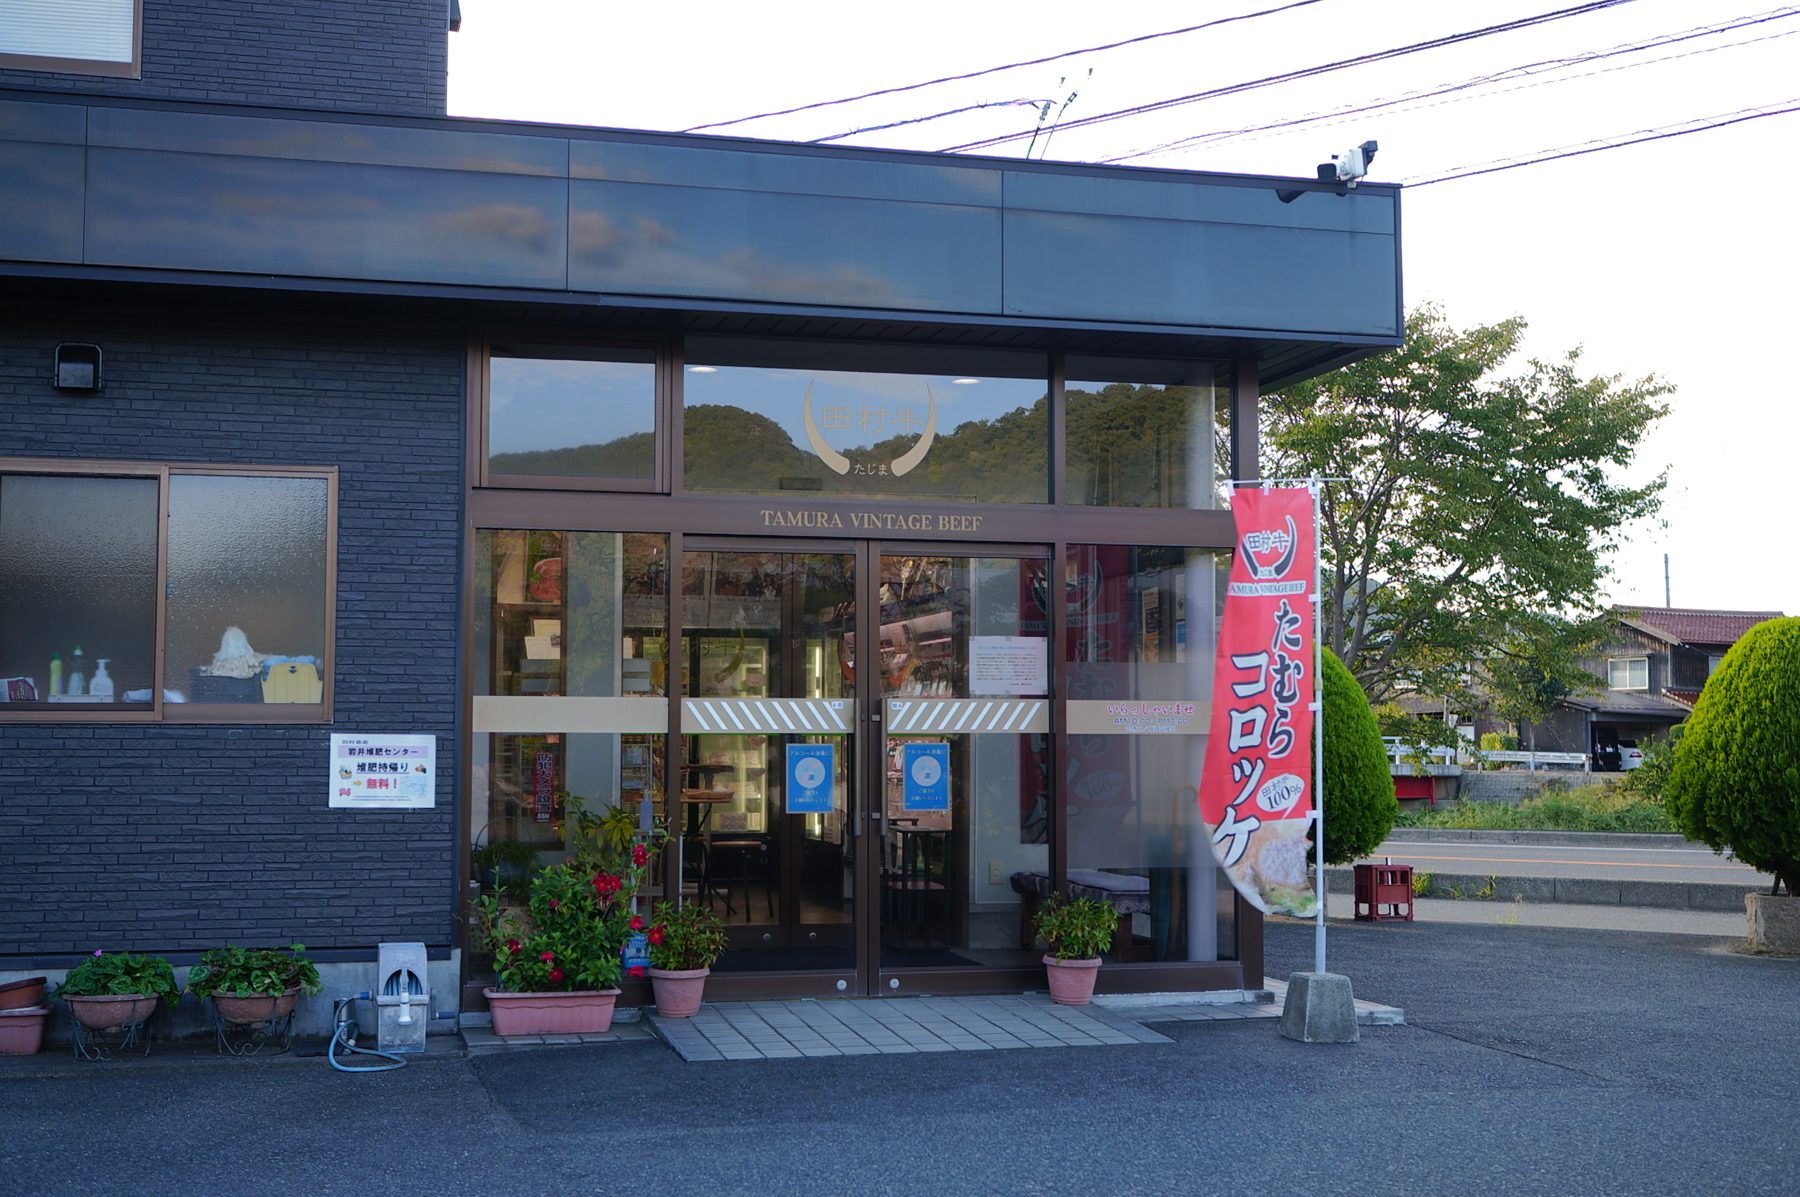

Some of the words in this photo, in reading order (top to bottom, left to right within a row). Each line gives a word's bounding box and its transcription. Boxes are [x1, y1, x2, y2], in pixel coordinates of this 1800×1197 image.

[822, 404, 923, 434] 田村牛
[853, 463, 889, 476] たじま
[760, 510, 843, 528] TAMURA
[850, 513, 932, 530] VINTAGE
[938, 515, 983, 531] BEEF
[1231, 583, 1260, 594] AMURA
[1268, 600, 1303, 757] たむら
[1107, 703, 1194, 715] いらっしゃいませ
[348, 747, 418, 756] 岩井堆肥センター
[1212, 650, 1269, 868] コロッケ
[357, 762, 409, 772] 堆肥持帰り
[366, 778, 397, 790] 無料！
[1267, 783, 1302, 810] 100%
